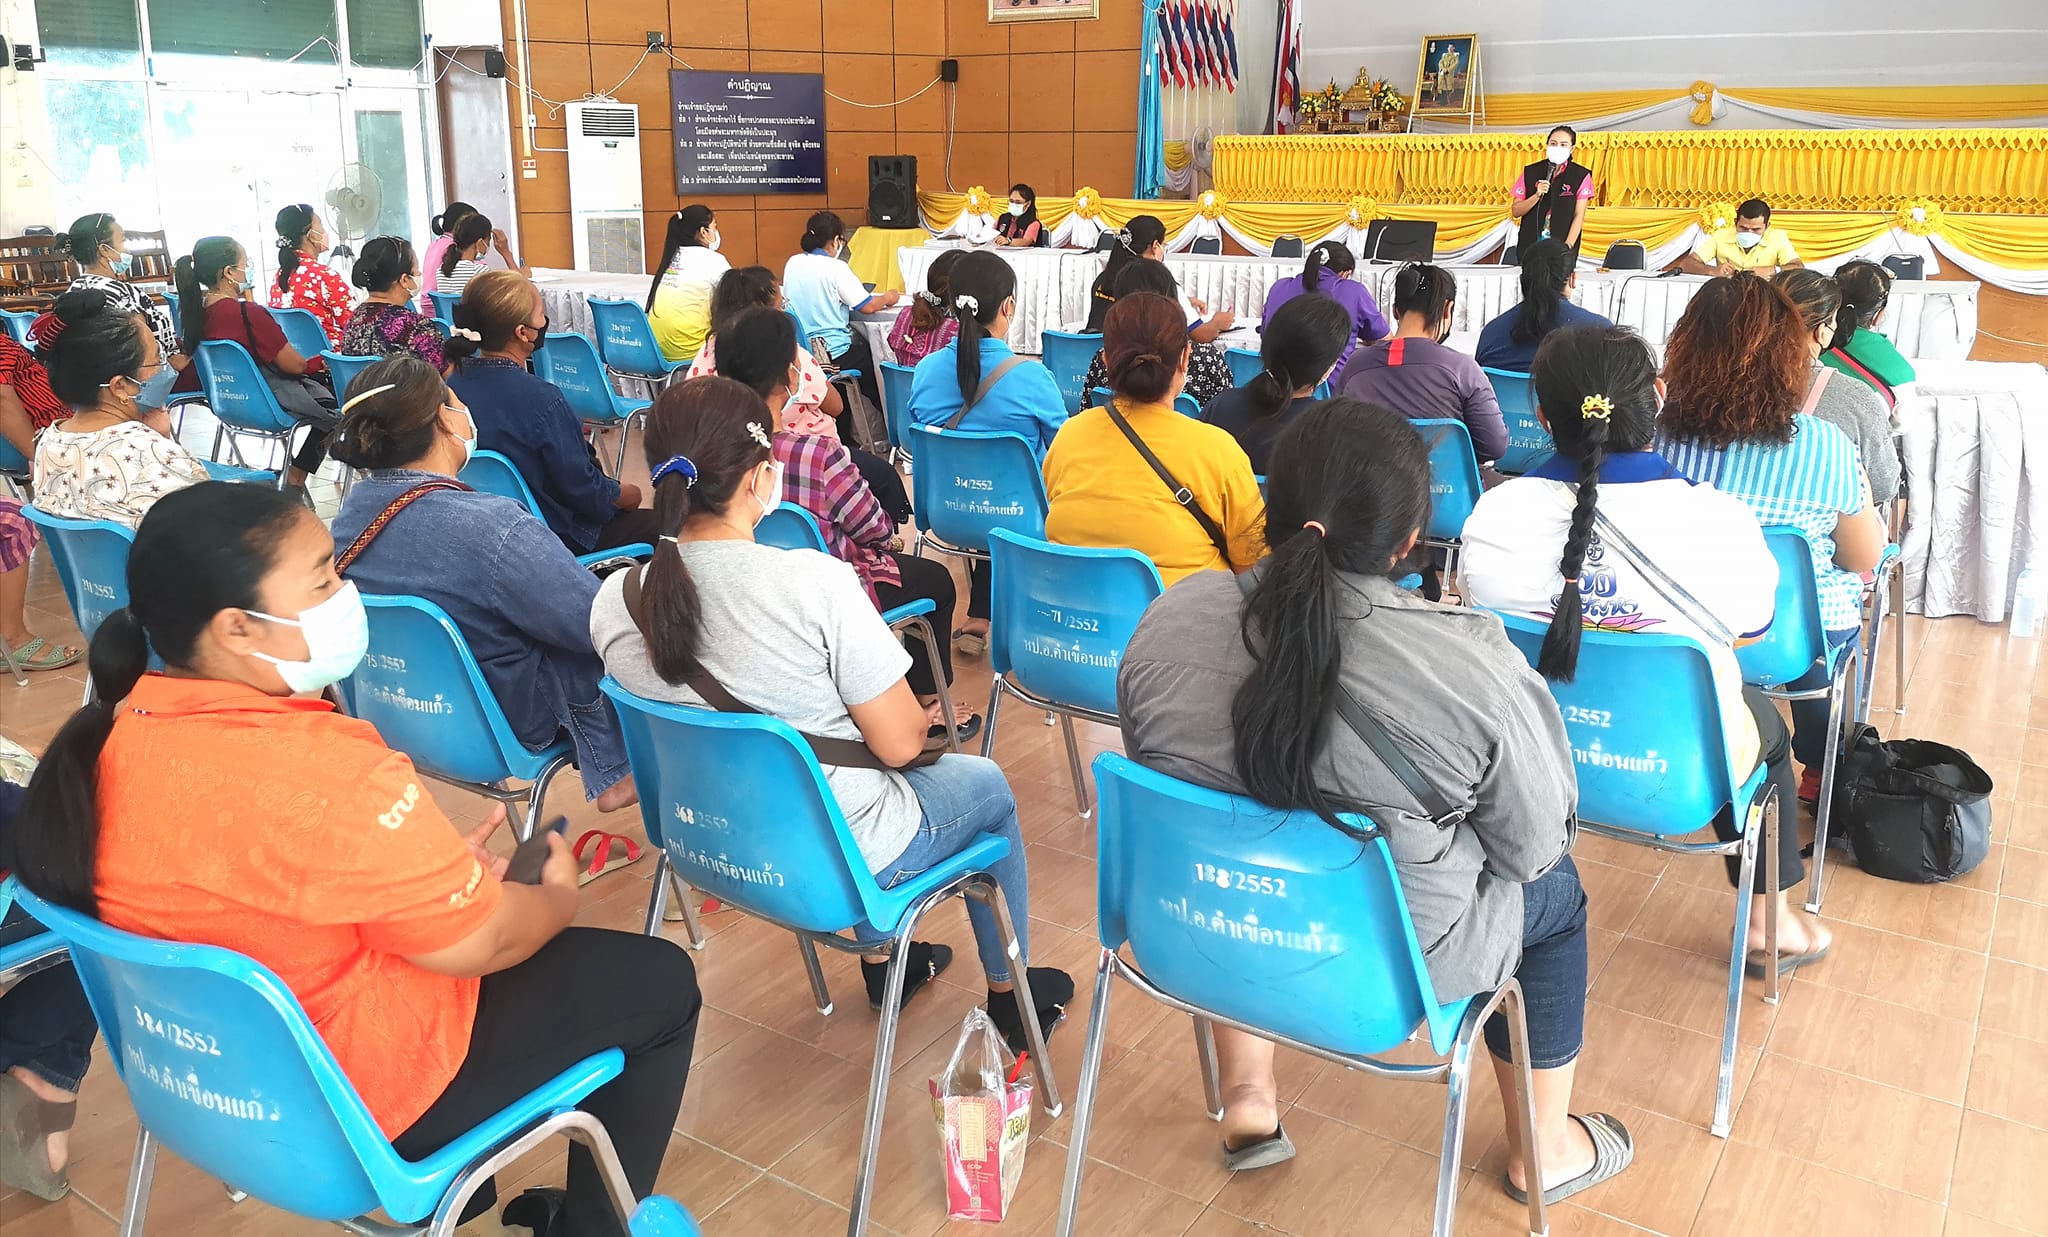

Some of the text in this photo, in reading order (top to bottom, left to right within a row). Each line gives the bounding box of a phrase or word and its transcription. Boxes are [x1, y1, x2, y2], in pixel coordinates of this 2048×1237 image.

[727, 78, 772, 93] คำปฏิญาณ
[377, 783, 420, 830] true
[133, 1004, 222, 1057] 384/2552
